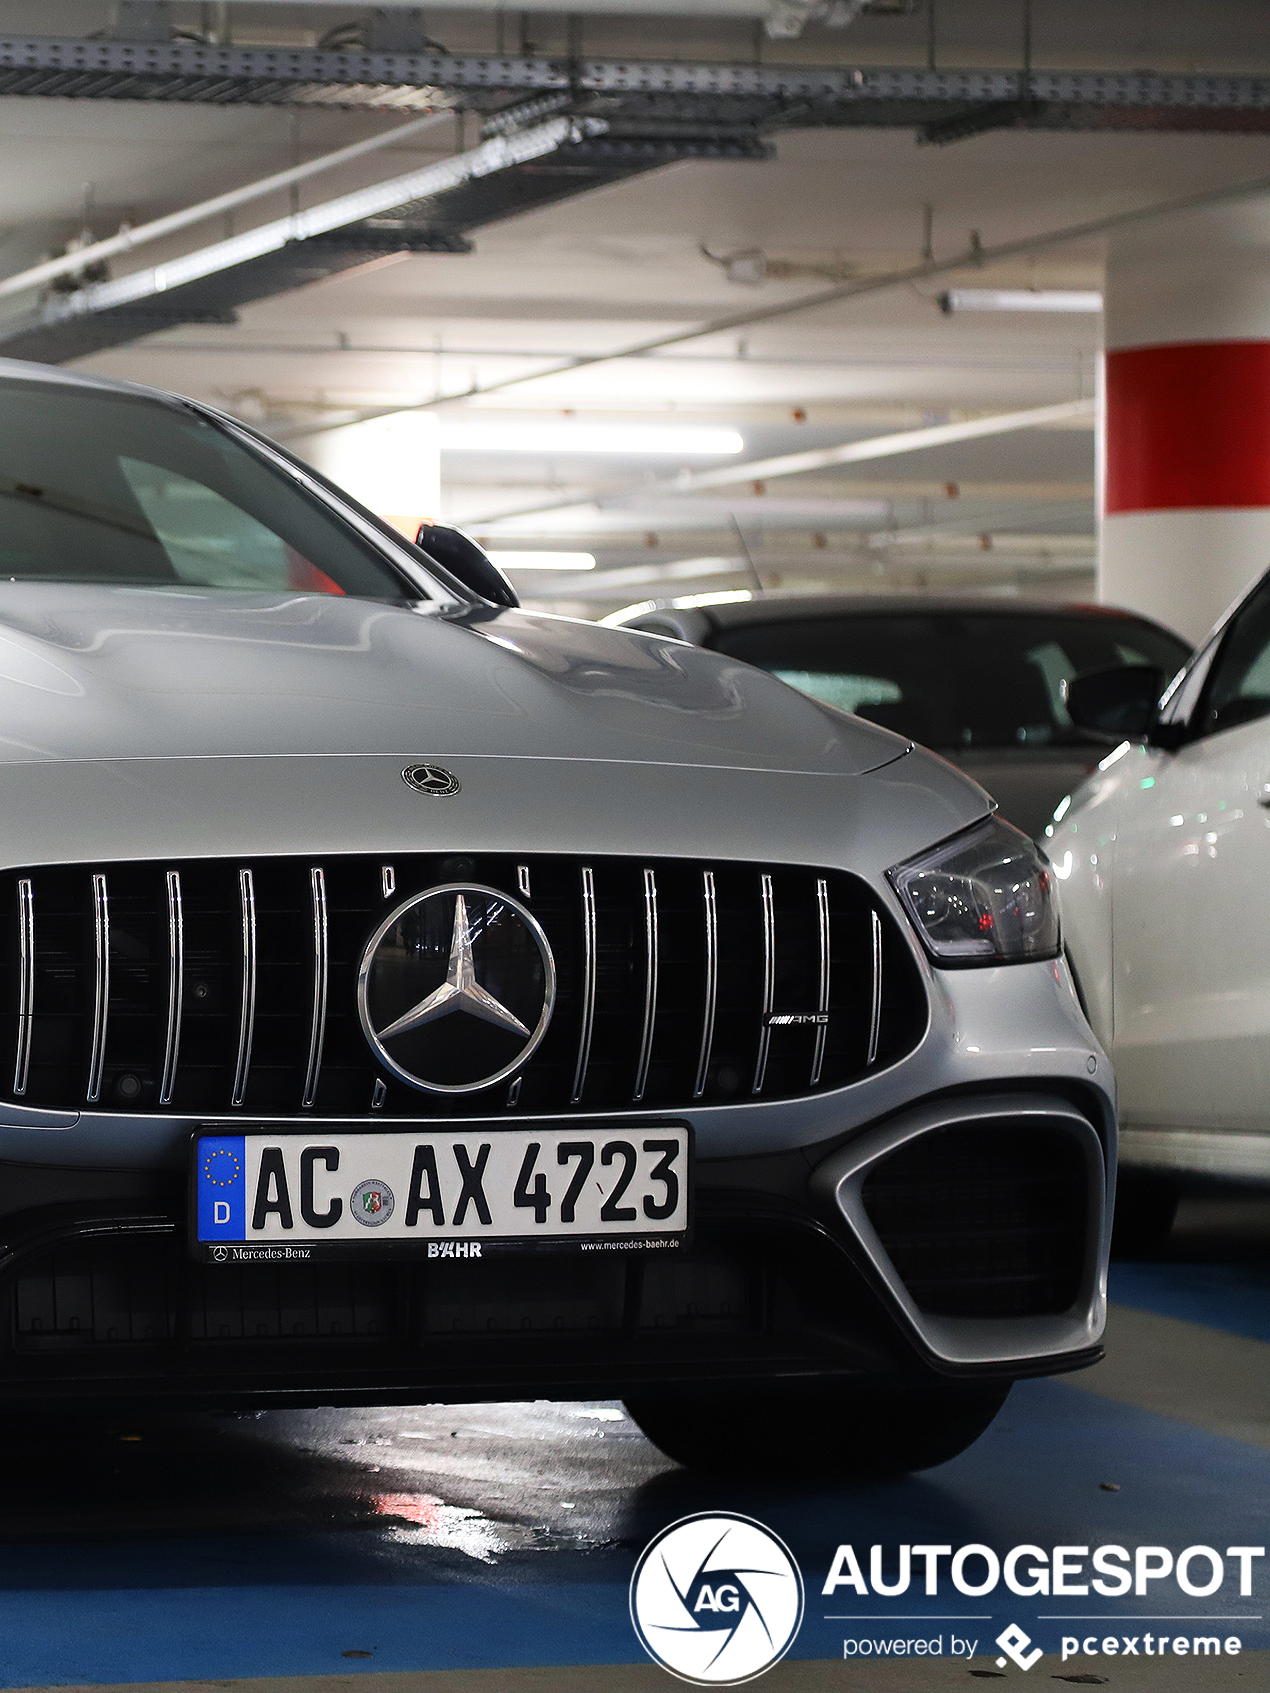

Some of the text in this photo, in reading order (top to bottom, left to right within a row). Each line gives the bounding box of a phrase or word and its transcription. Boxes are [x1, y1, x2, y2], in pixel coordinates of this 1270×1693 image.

[252, 1140, 680, 1230] AC AX 4723
[214, 1201, 231, 1224] D
[232, 1247, 311, 1260] Mercedes-Benz
[580, 1239, 680, 1251] www.mercedes-baehr.de
